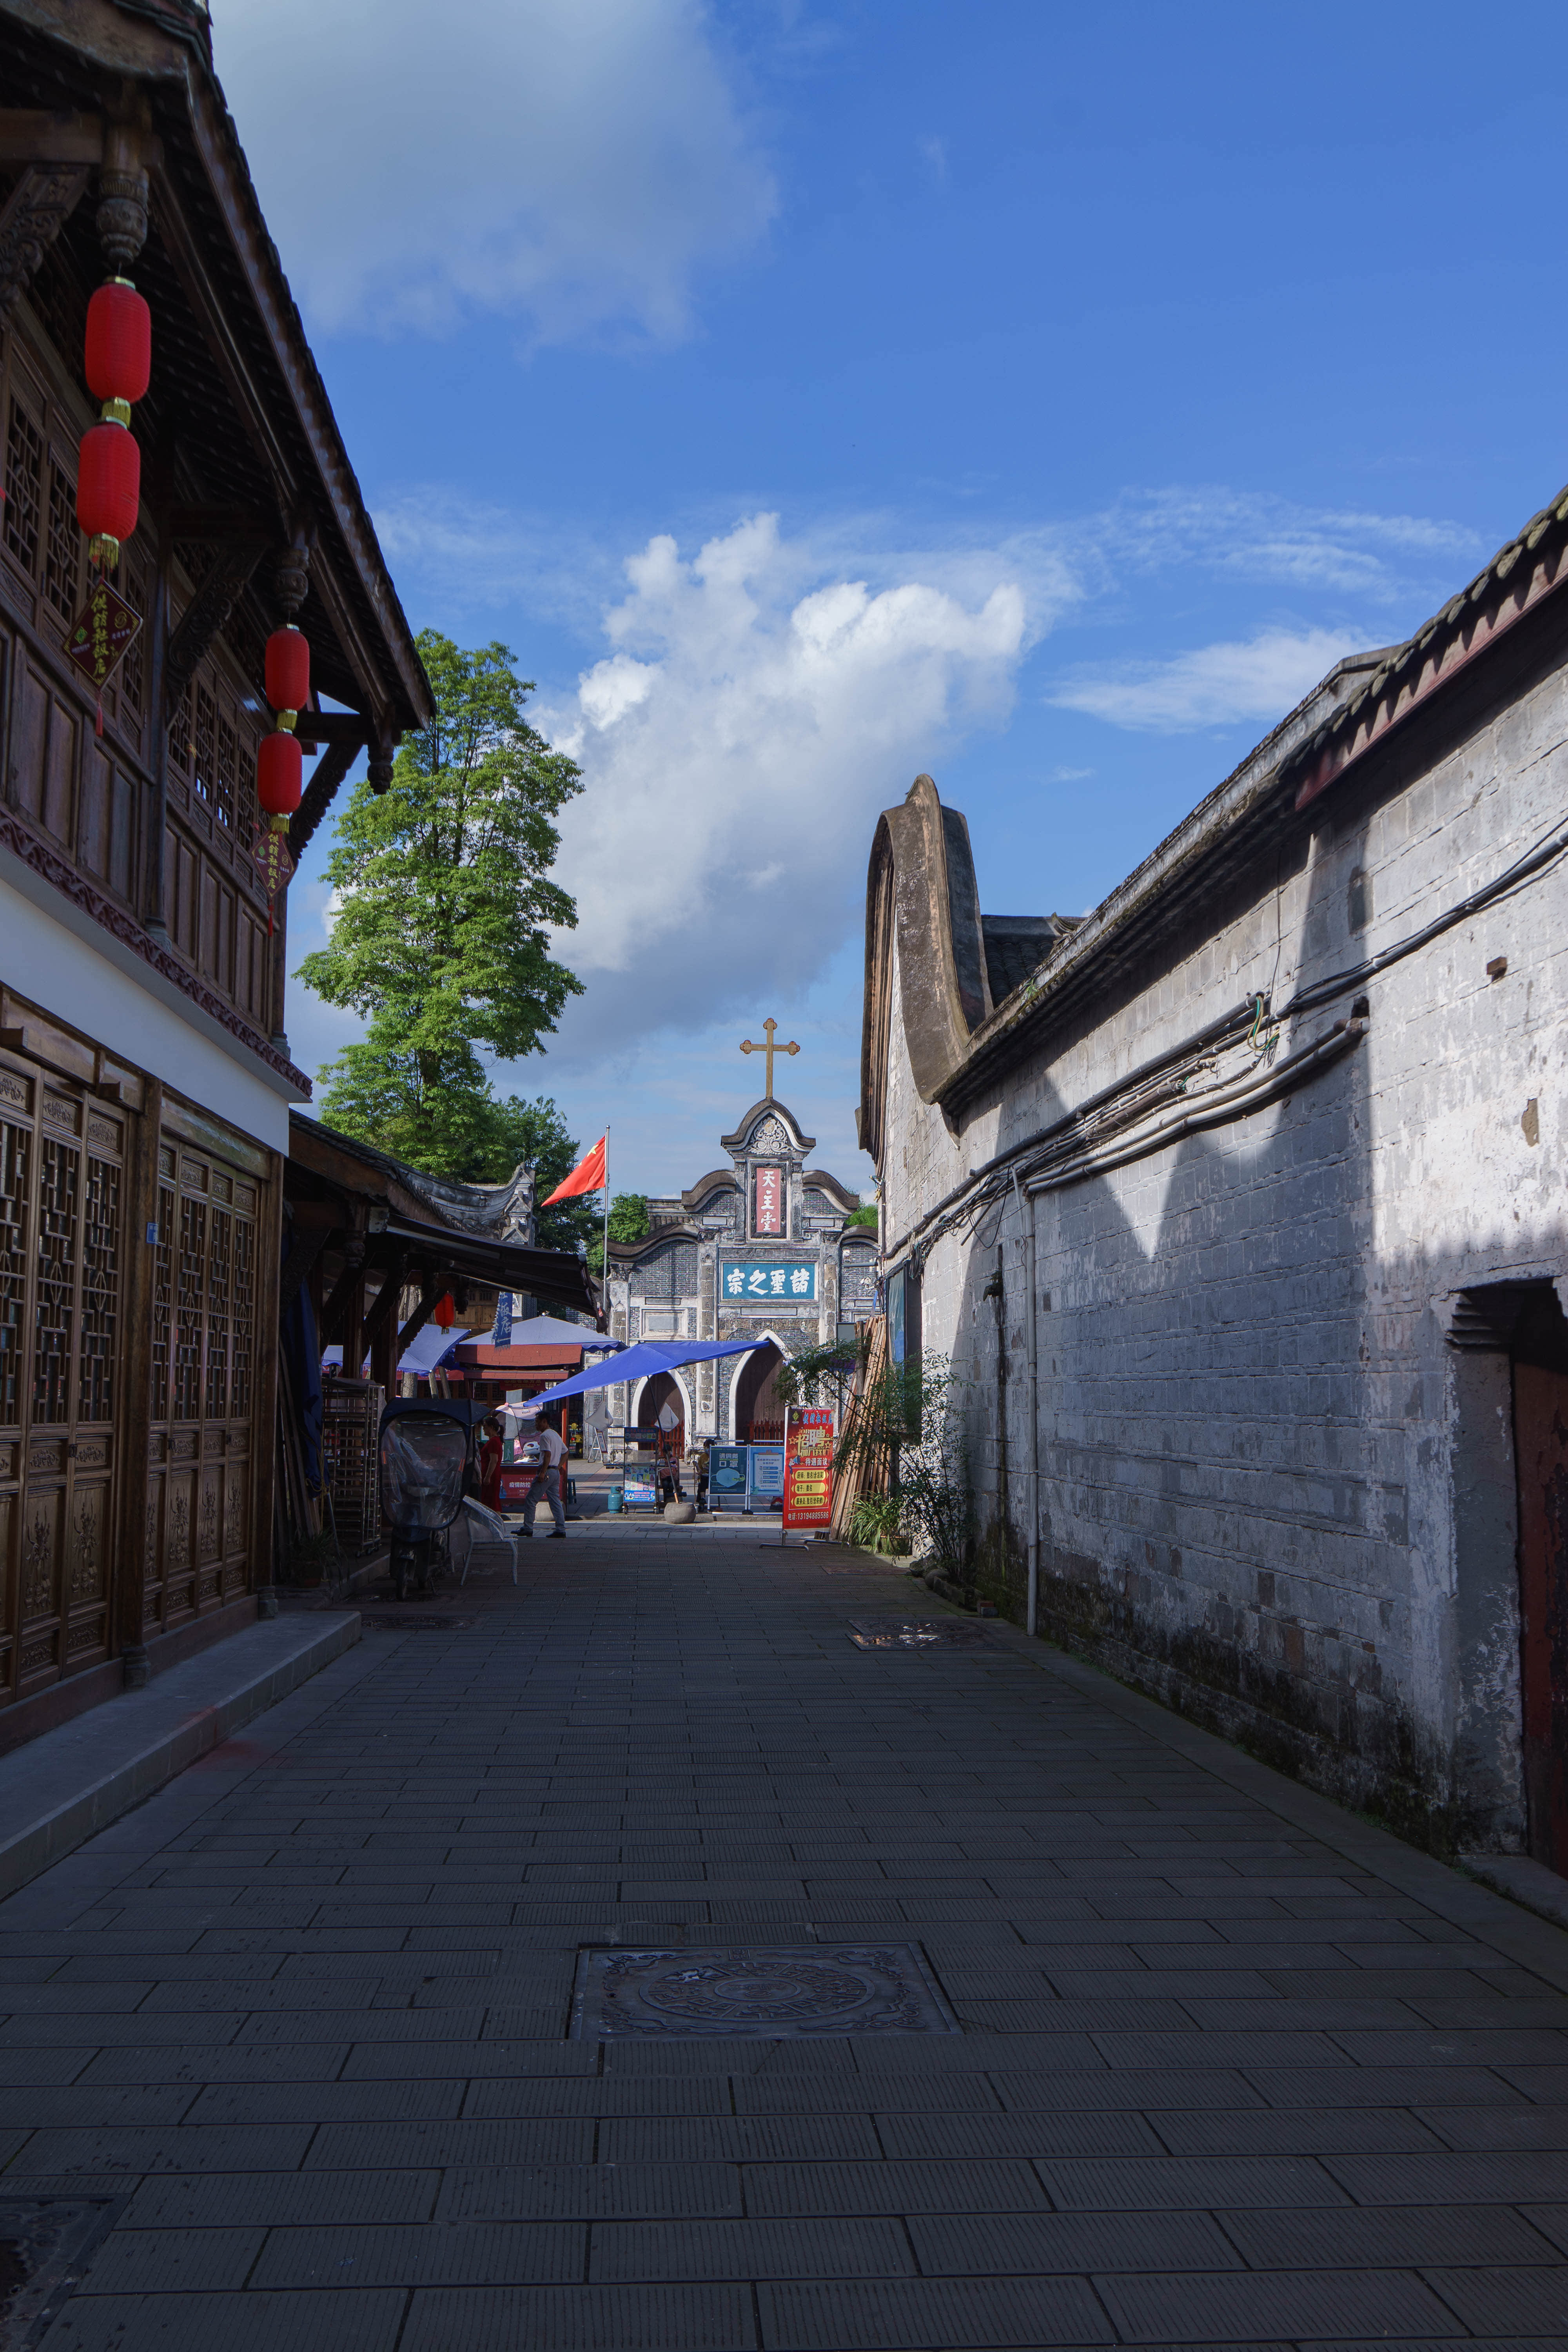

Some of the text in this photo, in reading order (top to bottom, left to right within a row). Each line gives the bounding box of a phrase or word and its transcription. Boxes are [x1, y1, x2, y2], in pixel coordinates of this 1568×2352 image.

[760, 1171, 776, 1231] 天主堂
[796, 1426, 830, 1455] 招聘
